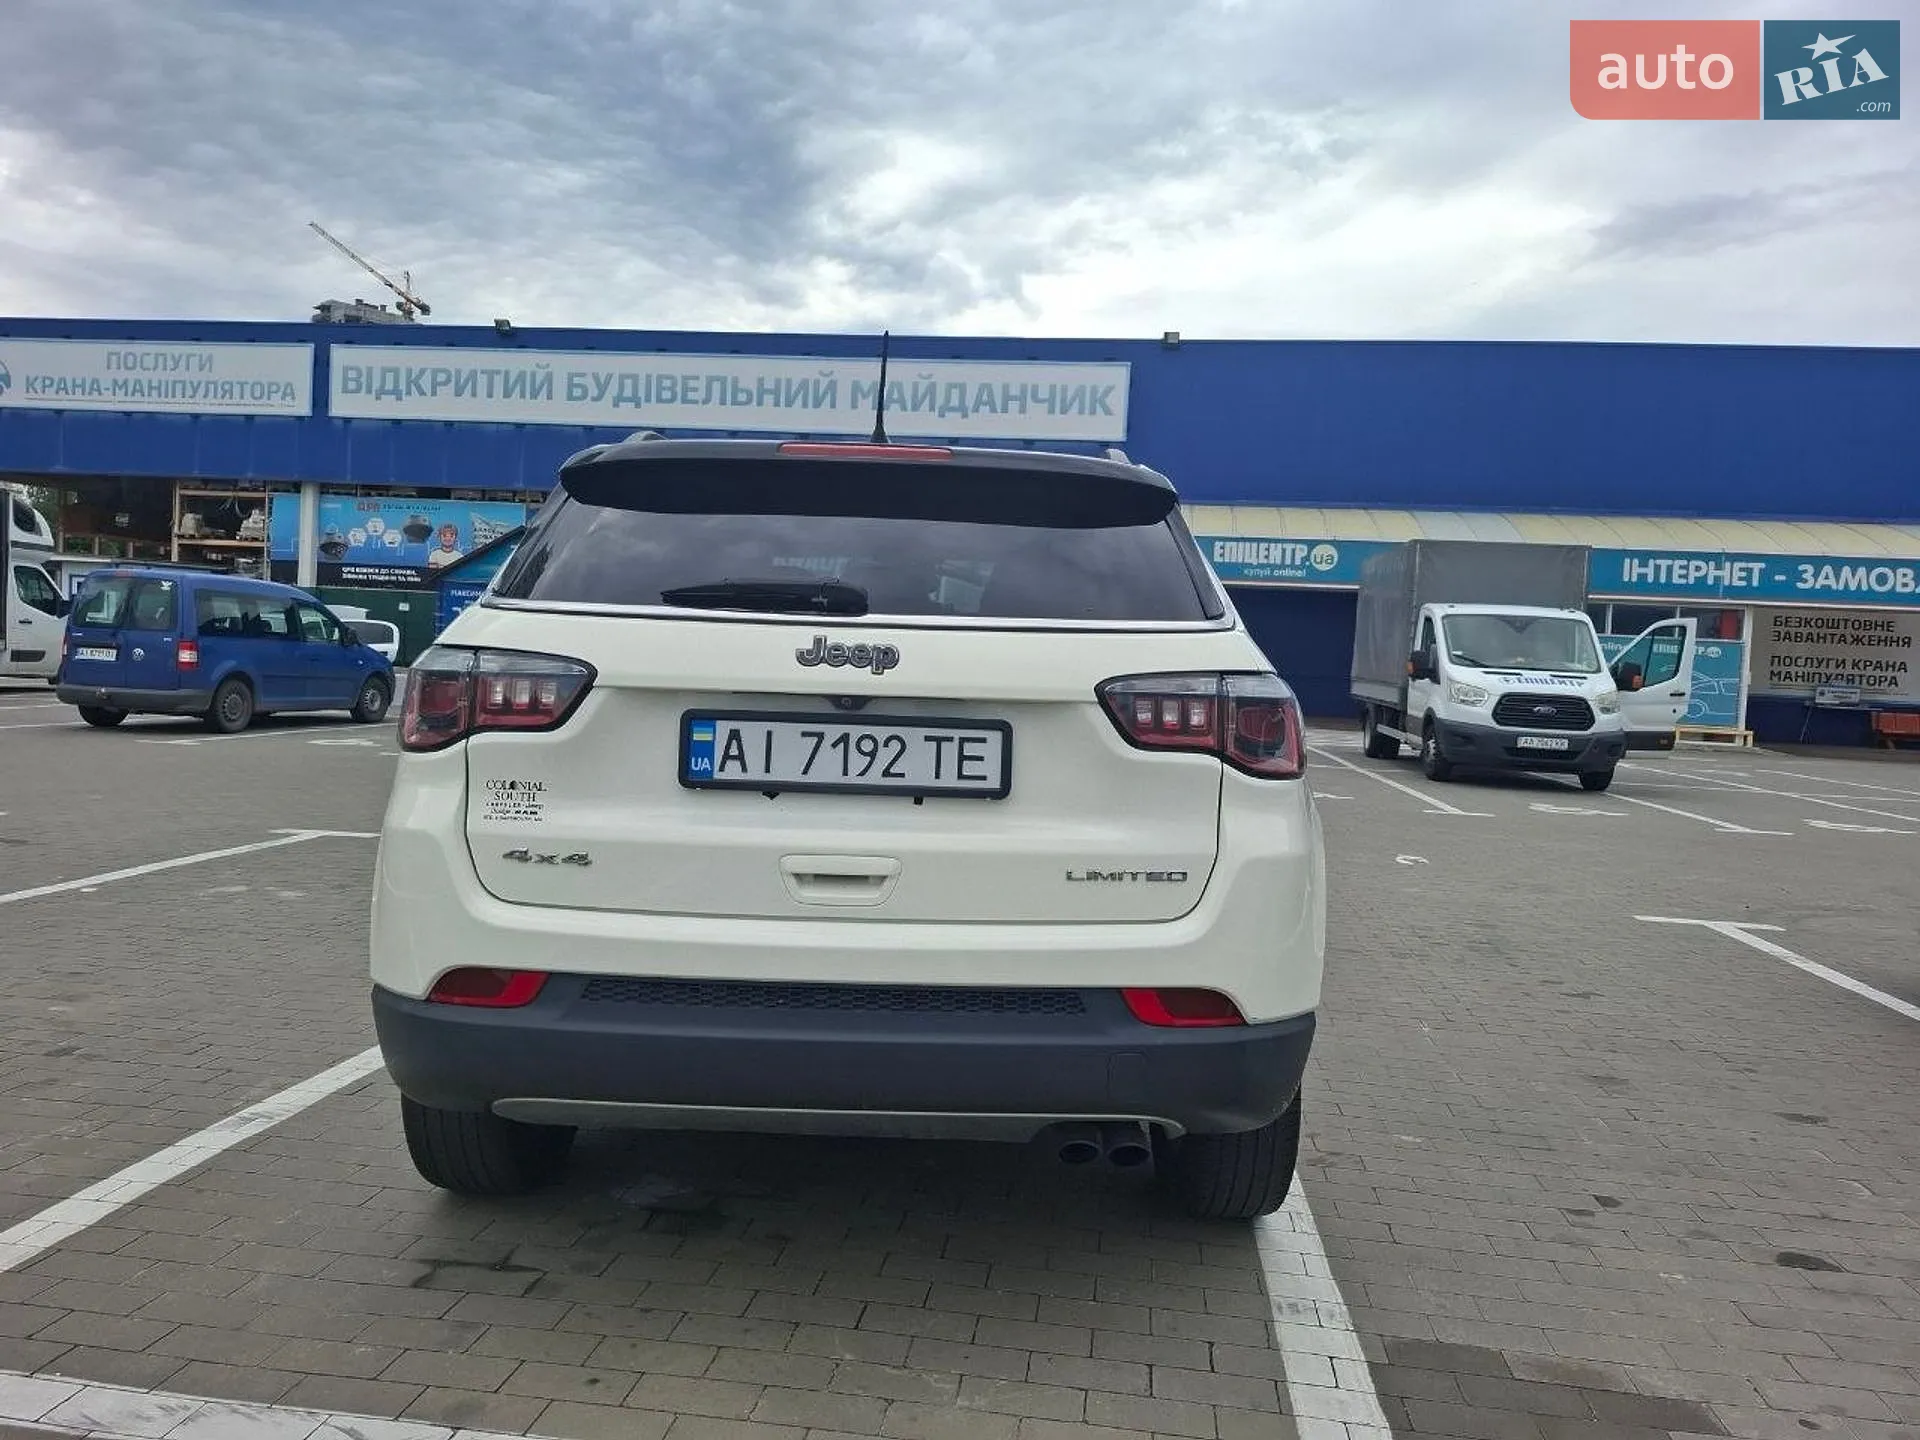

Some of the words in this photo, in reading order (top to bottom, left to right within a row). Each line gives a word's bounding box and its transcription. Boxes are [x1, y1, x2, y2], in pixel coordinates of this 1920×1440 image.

[106, 351, 214, 373] ПОСЛУГИ
[25, 375, 297, 402] КРАНА-МАНІПУЛЯТОРА
[341, 363, 554, 401] ВІДКРИТИЙ
[566, 370, 838, 410] БУДІВЕЛЬНИЙ
[850, 372, 1115, 419] МАЙДАНЧИК
[1622, 558, 1766, 588] ІНТЕРНЕТ
[1796, 564, 1920, 594] ЗАМОВ
[1773, 616, 1896, 633] БЕЗКОШТОВНЕ
[1772, 630, 1912, 648] ЗАВАНТАЖЕННЯ
[795, 635, 900, 675] Jeep
[1770, 655, 1846, 669] ПОСЛУГИ
[1851, 658, 1908, 673] КРАНА
[1769, 670, 1899, 688] МАНІПУЛЯТОРА
[718, 728, 773, 774] AI
[800, 731, 908, 779] 7192
[923, 735, 988, 782] TE
[691, 757, 712, 772] UA
[486, 780, 547, 791] COLONIAL
[494, 791, 536, 802] SOUTH
[1066, 870, 1188, 882] LIMITED
